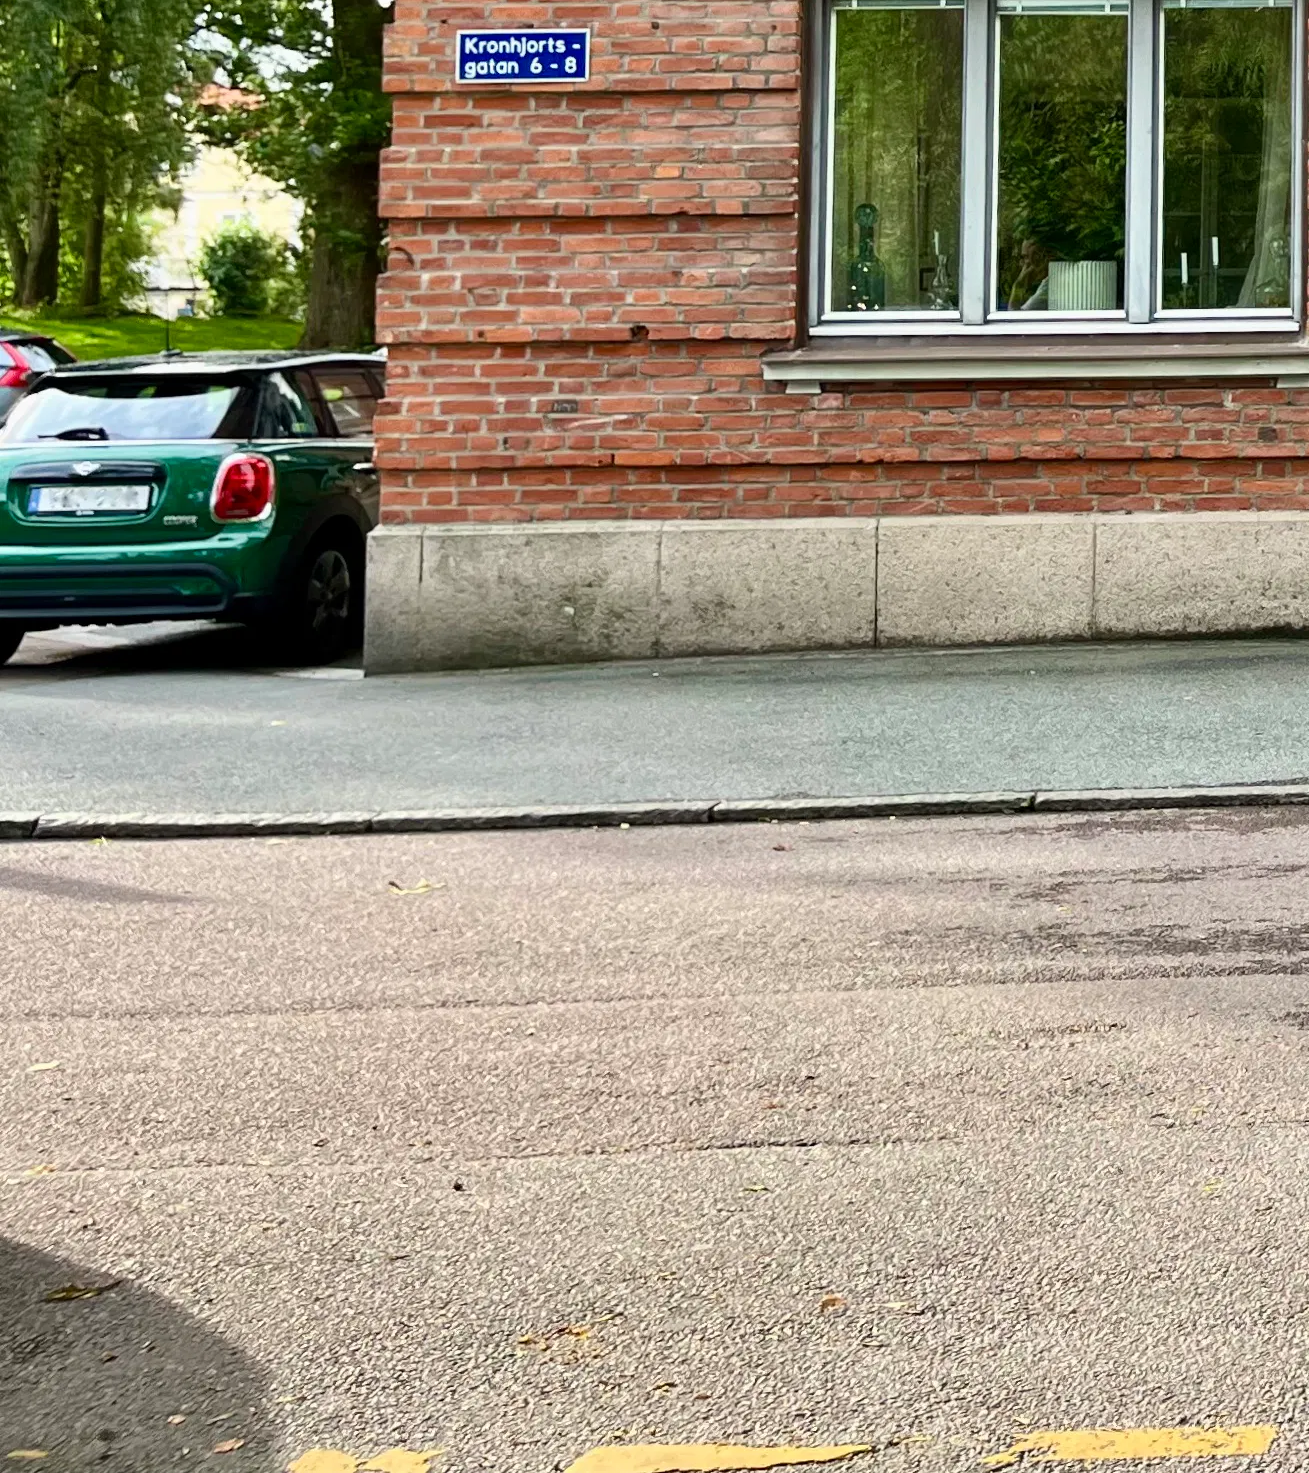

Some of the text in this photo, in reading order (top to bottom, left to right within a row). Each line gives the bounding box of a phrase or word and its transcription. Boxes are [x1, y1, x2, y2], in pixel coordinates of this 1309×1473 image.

[464, 37, 567, 57] Kronhjorts
[464, 58, 519, 78] gatan
[530, 57, 543, 74] 6
[564, 56, 577, 74] 8
